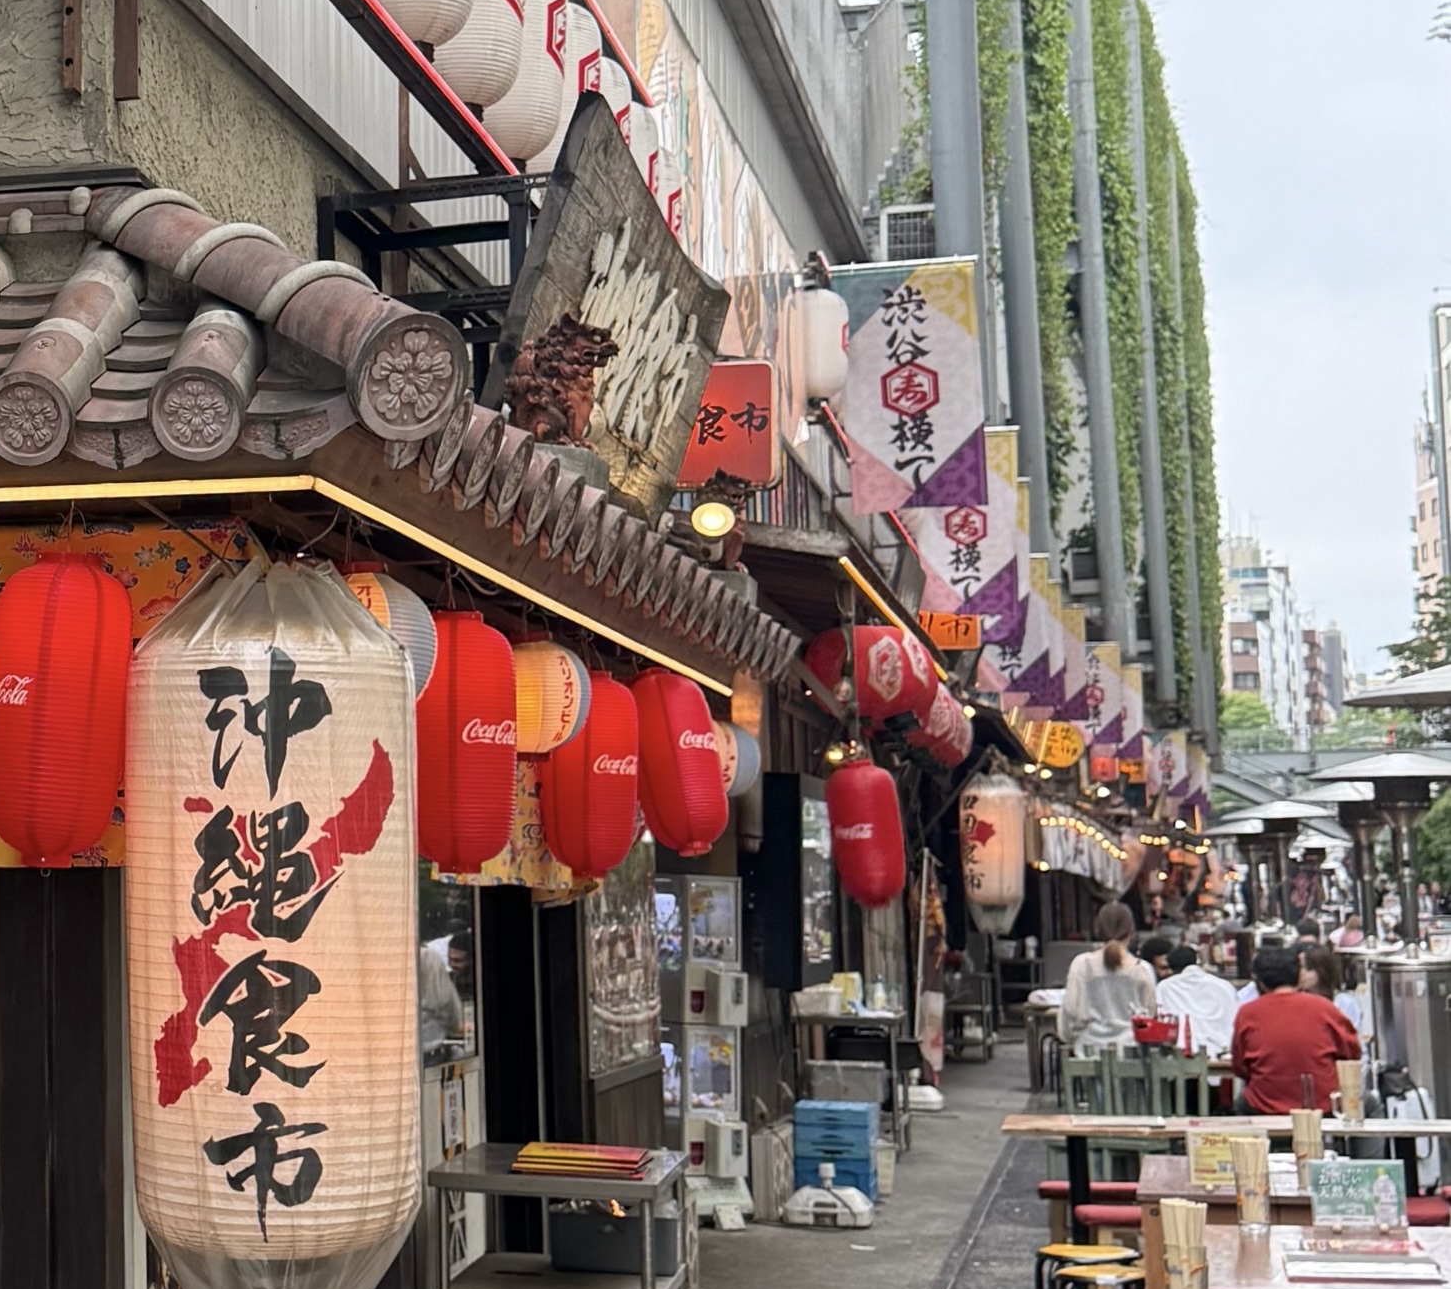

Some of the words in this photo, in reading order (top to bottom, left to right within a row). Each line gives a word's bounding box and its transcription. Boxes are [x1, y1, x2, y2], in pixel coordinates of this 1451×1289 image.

[552, 655, 577, 742] オリオンビール
[191, 646, 346, 1242] 沖縄食市
